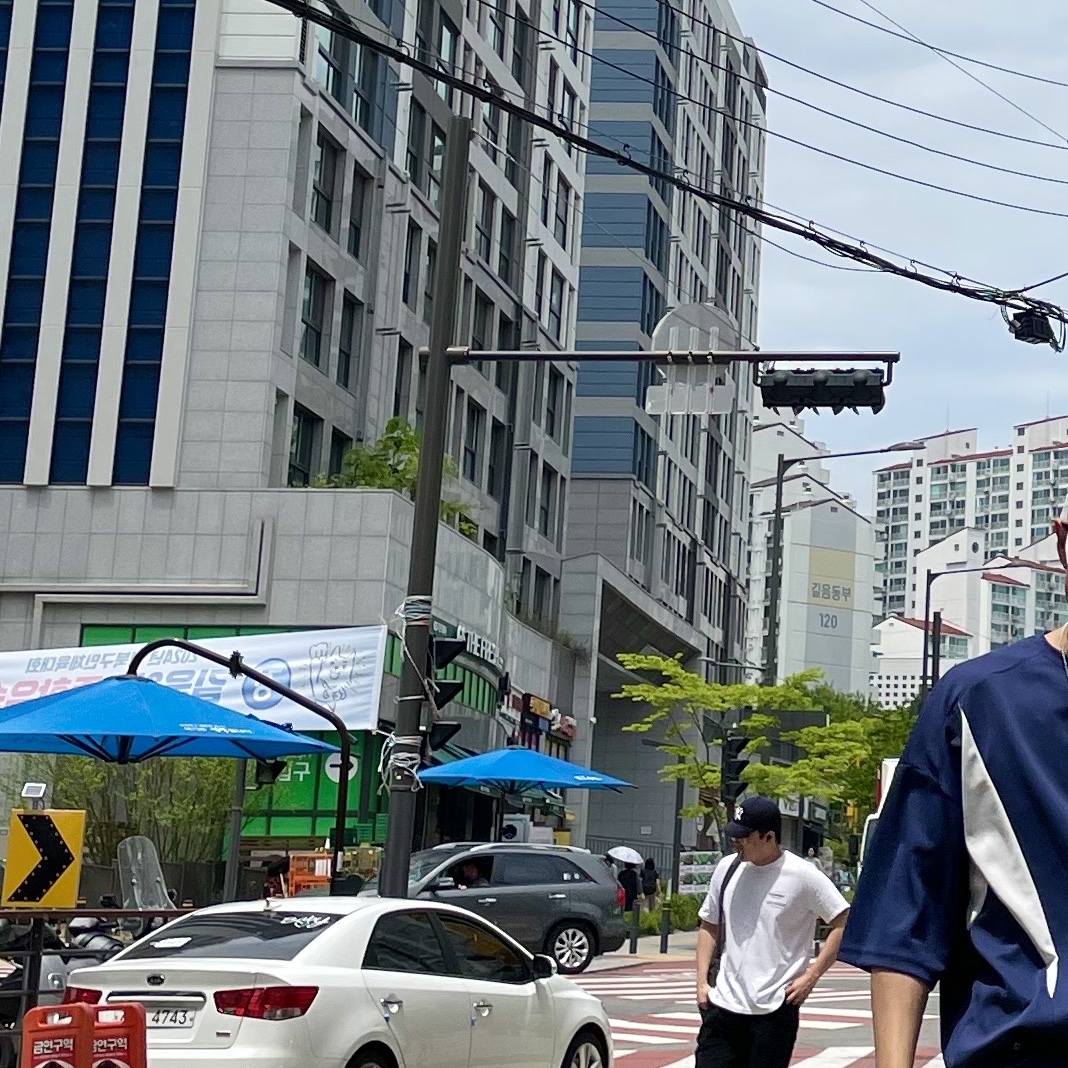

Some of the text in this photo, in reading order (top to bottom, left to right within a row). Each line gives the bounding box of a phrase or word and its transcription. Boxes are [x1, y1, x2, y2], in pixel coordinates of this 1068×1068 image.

[811, 583, 851, 602] 길음동부
[819, 613, 838, 629] 120
[151, 1009, 187, 1025] 4743
[33, 1038, 74, 1055] 금연구역
